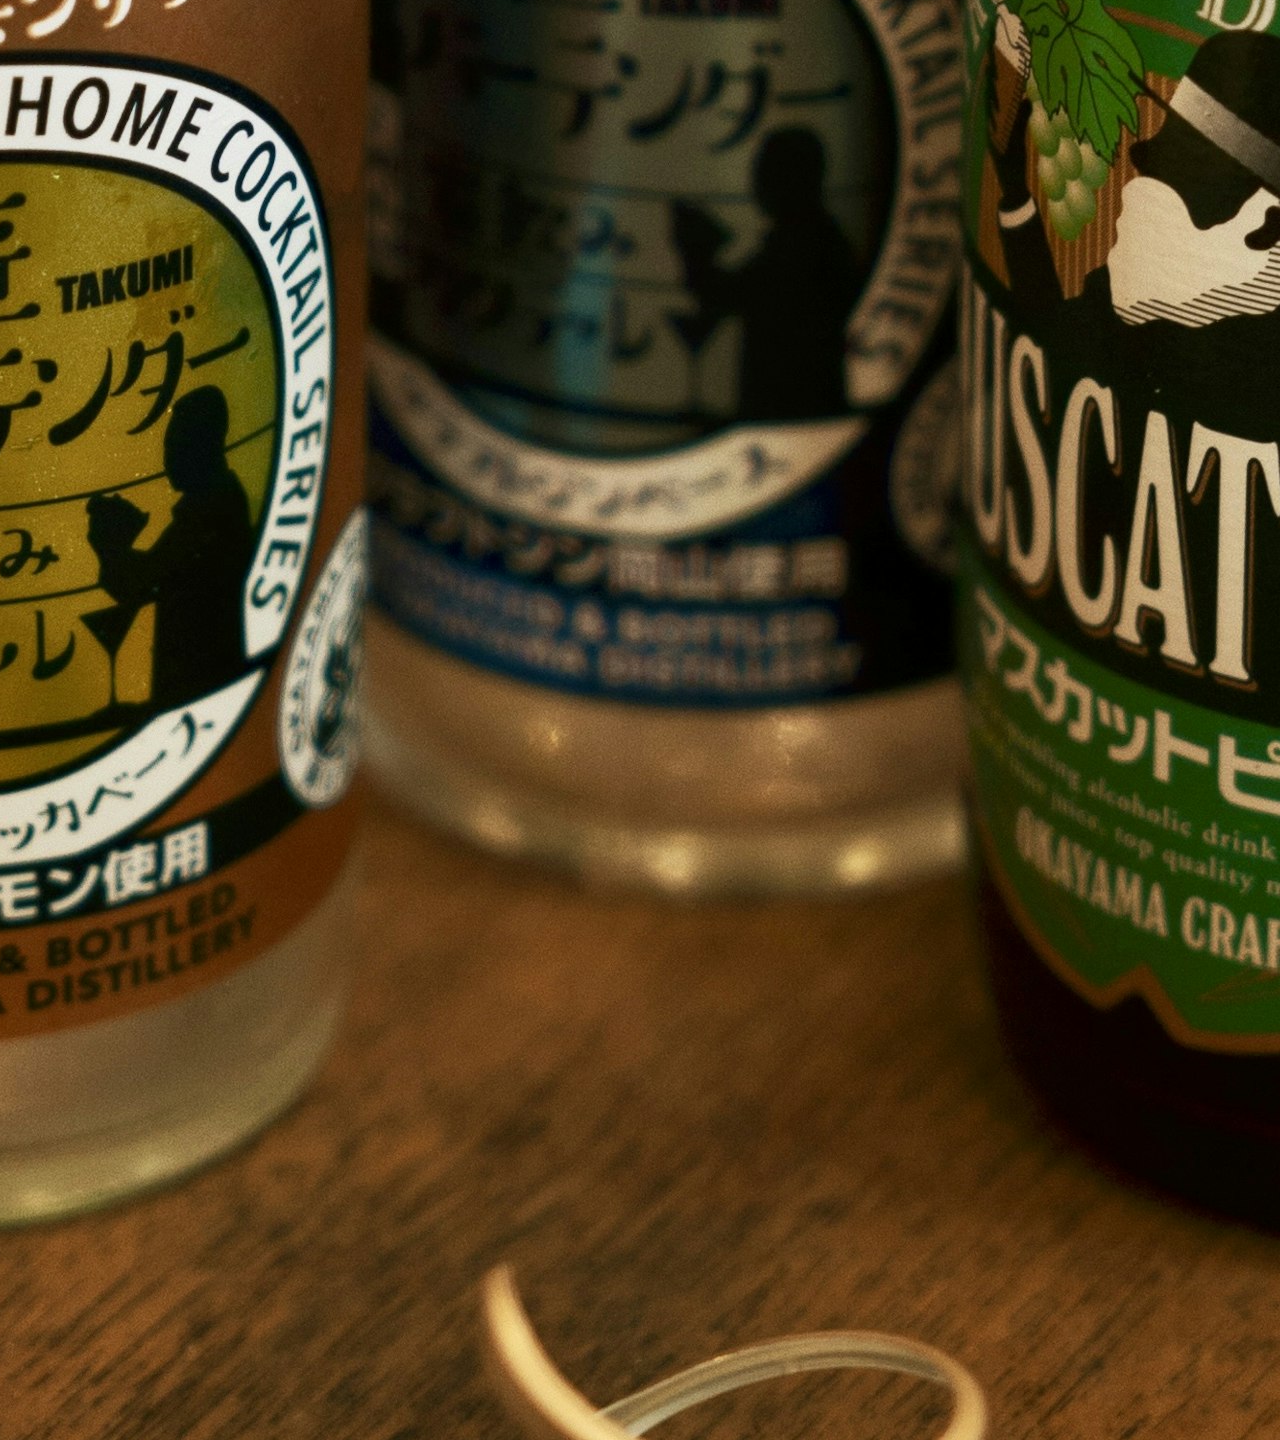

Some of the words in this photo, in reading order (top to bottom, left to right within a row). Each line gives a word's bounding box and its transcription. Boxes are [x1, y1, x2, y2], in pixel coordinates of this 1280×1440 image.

[4, 74, 214, 162] HOME
[54, 244, 196, 316] TAKUMI
[210, 119, 327, 376] COCKTAIL
[251, 376, 327, 613] SERIES
[1086, 777, 1192, 838] alcoholic
[1201, 821, 1278, 862] drink
[1114, 826, 1155, 861] top
[1161, 848, 1255, 895] quality
[1014, 805, 1171, 939] OKAYAMA
[26, 906, 258, 1014] DISTILLERY
[45, 882, 238, 971] BOTTLED
